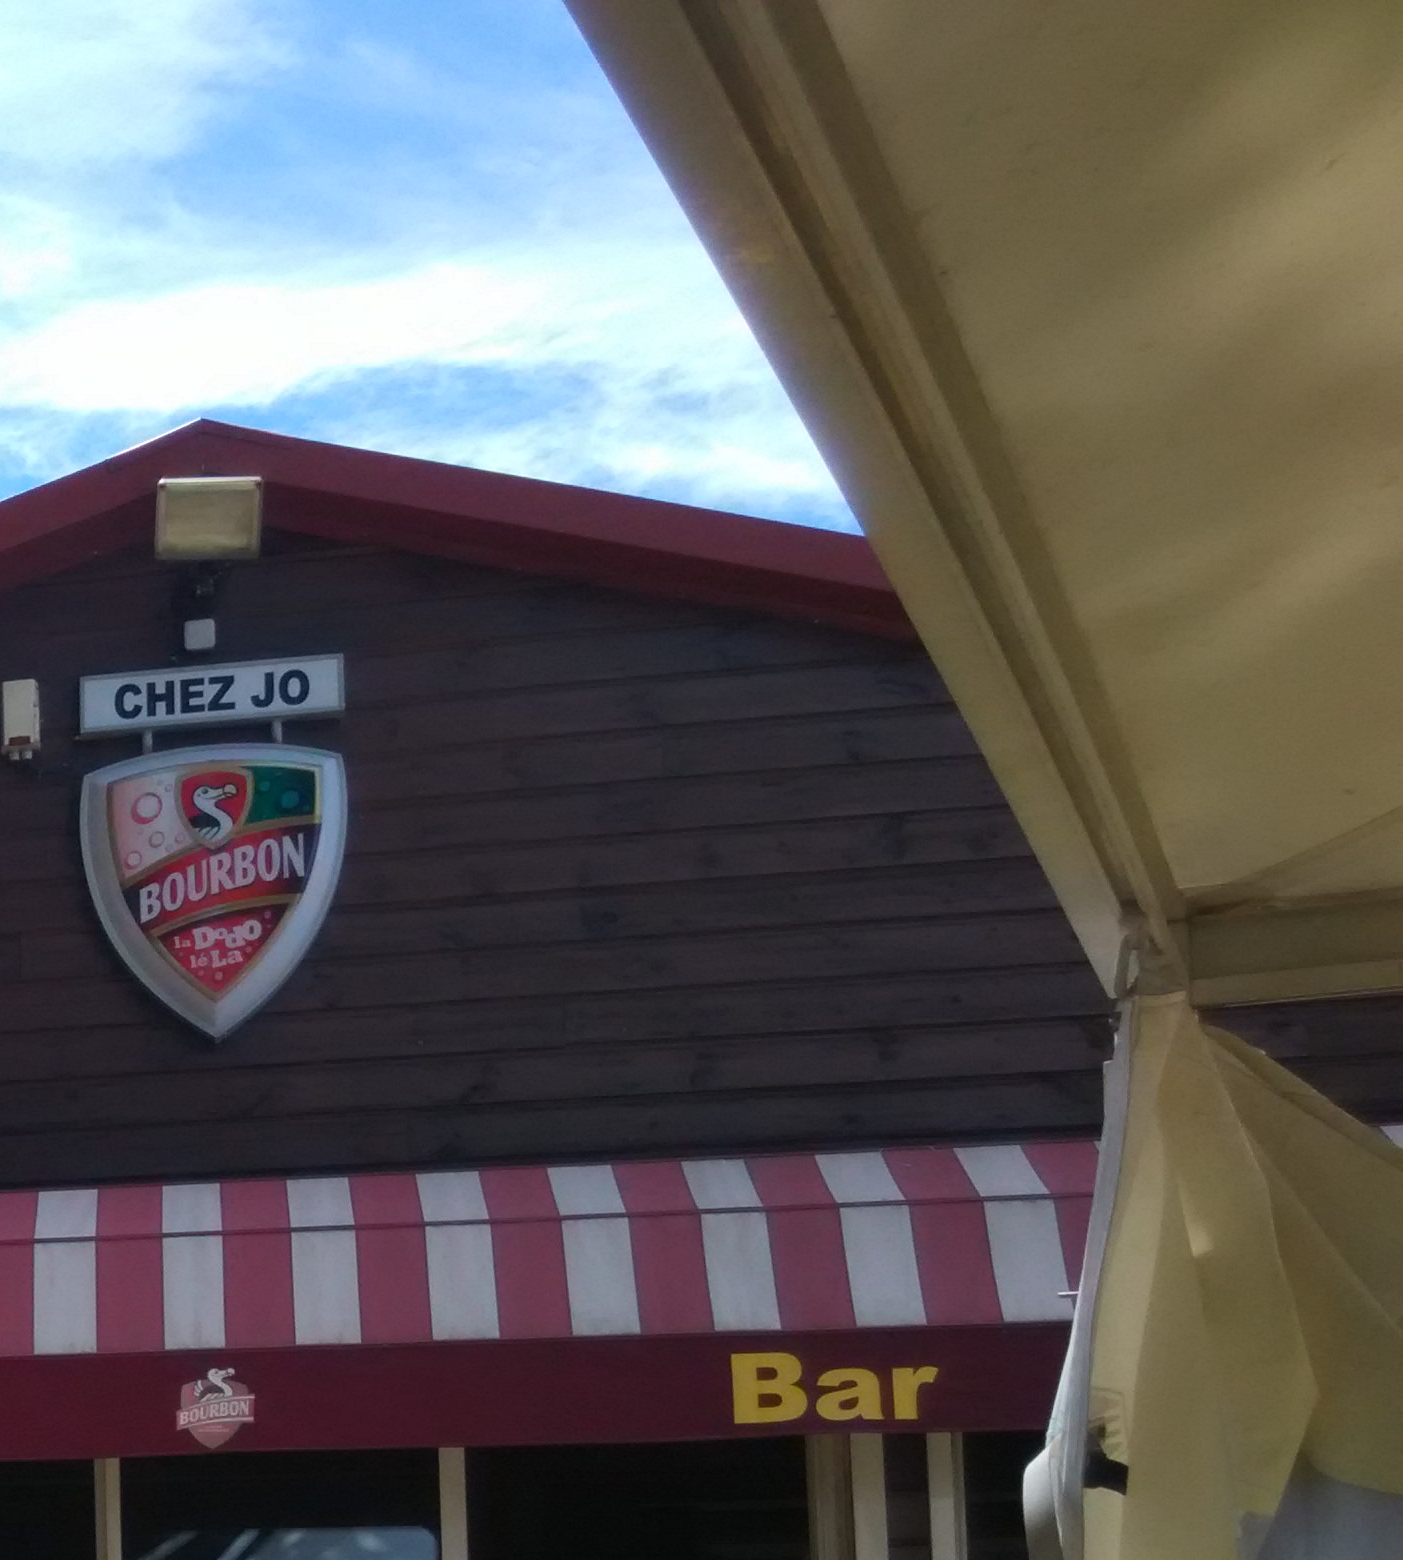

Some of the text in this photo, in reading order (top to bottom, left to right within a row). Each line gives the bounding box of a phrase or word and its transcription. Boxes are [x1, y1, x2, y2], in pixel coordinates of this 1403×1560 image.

[113, 668, 310, 720] CHEZ JO
[138, 833, 305, 924] BOURBON
[209, 949, 244, 968] La
[179, 1400, 249, 1425] BOURBON
[730, 1351, 939, 1425] Bar
